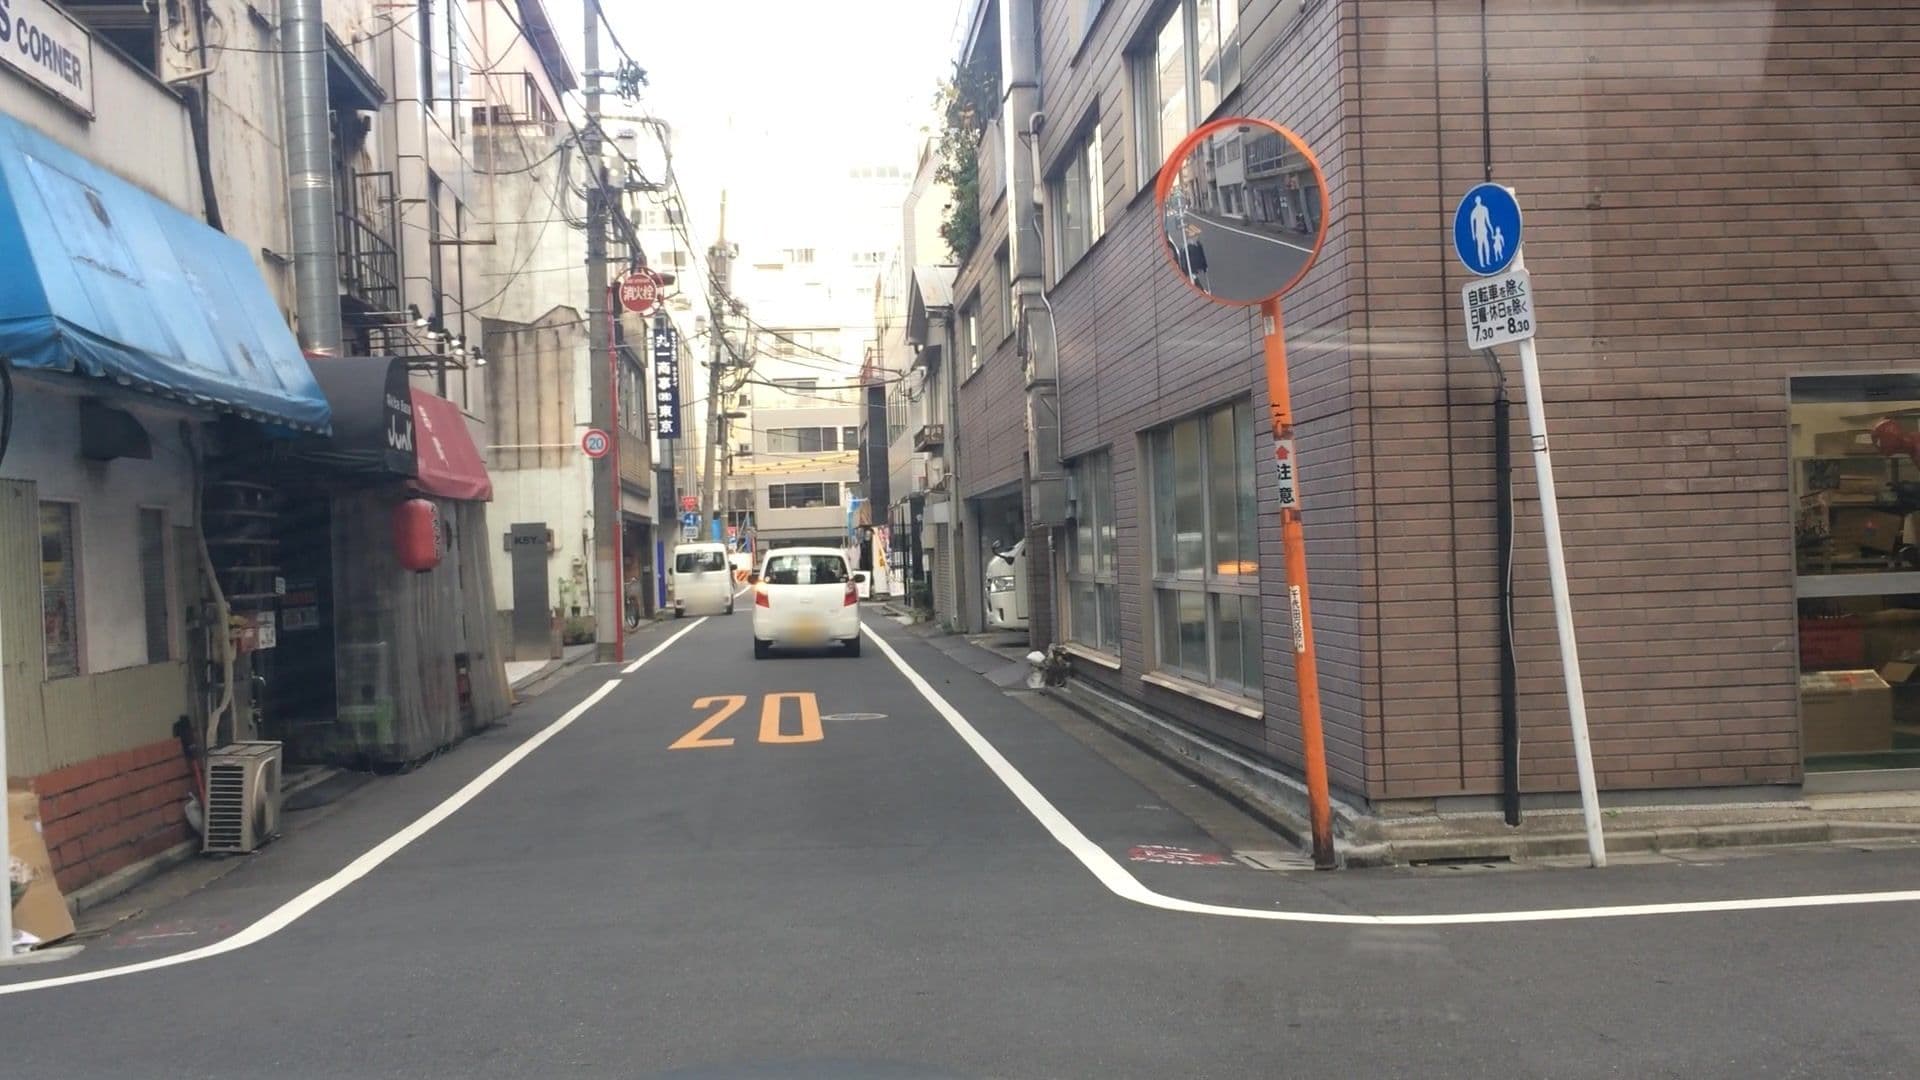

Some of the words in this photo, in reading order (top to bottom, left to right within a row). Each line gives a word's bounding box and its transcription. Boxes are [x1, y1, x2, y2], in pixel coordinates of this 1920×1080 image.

[16, 16, 82, 92] CORNER
[624, 286, 655, 302] 消火栓
[1468, 279, 1525, 306] 自転車を除く
[588, 437, 602, 451] 20
[1277, 463, 1295, 504] 注意
[668, 692, 824, 750] 20
